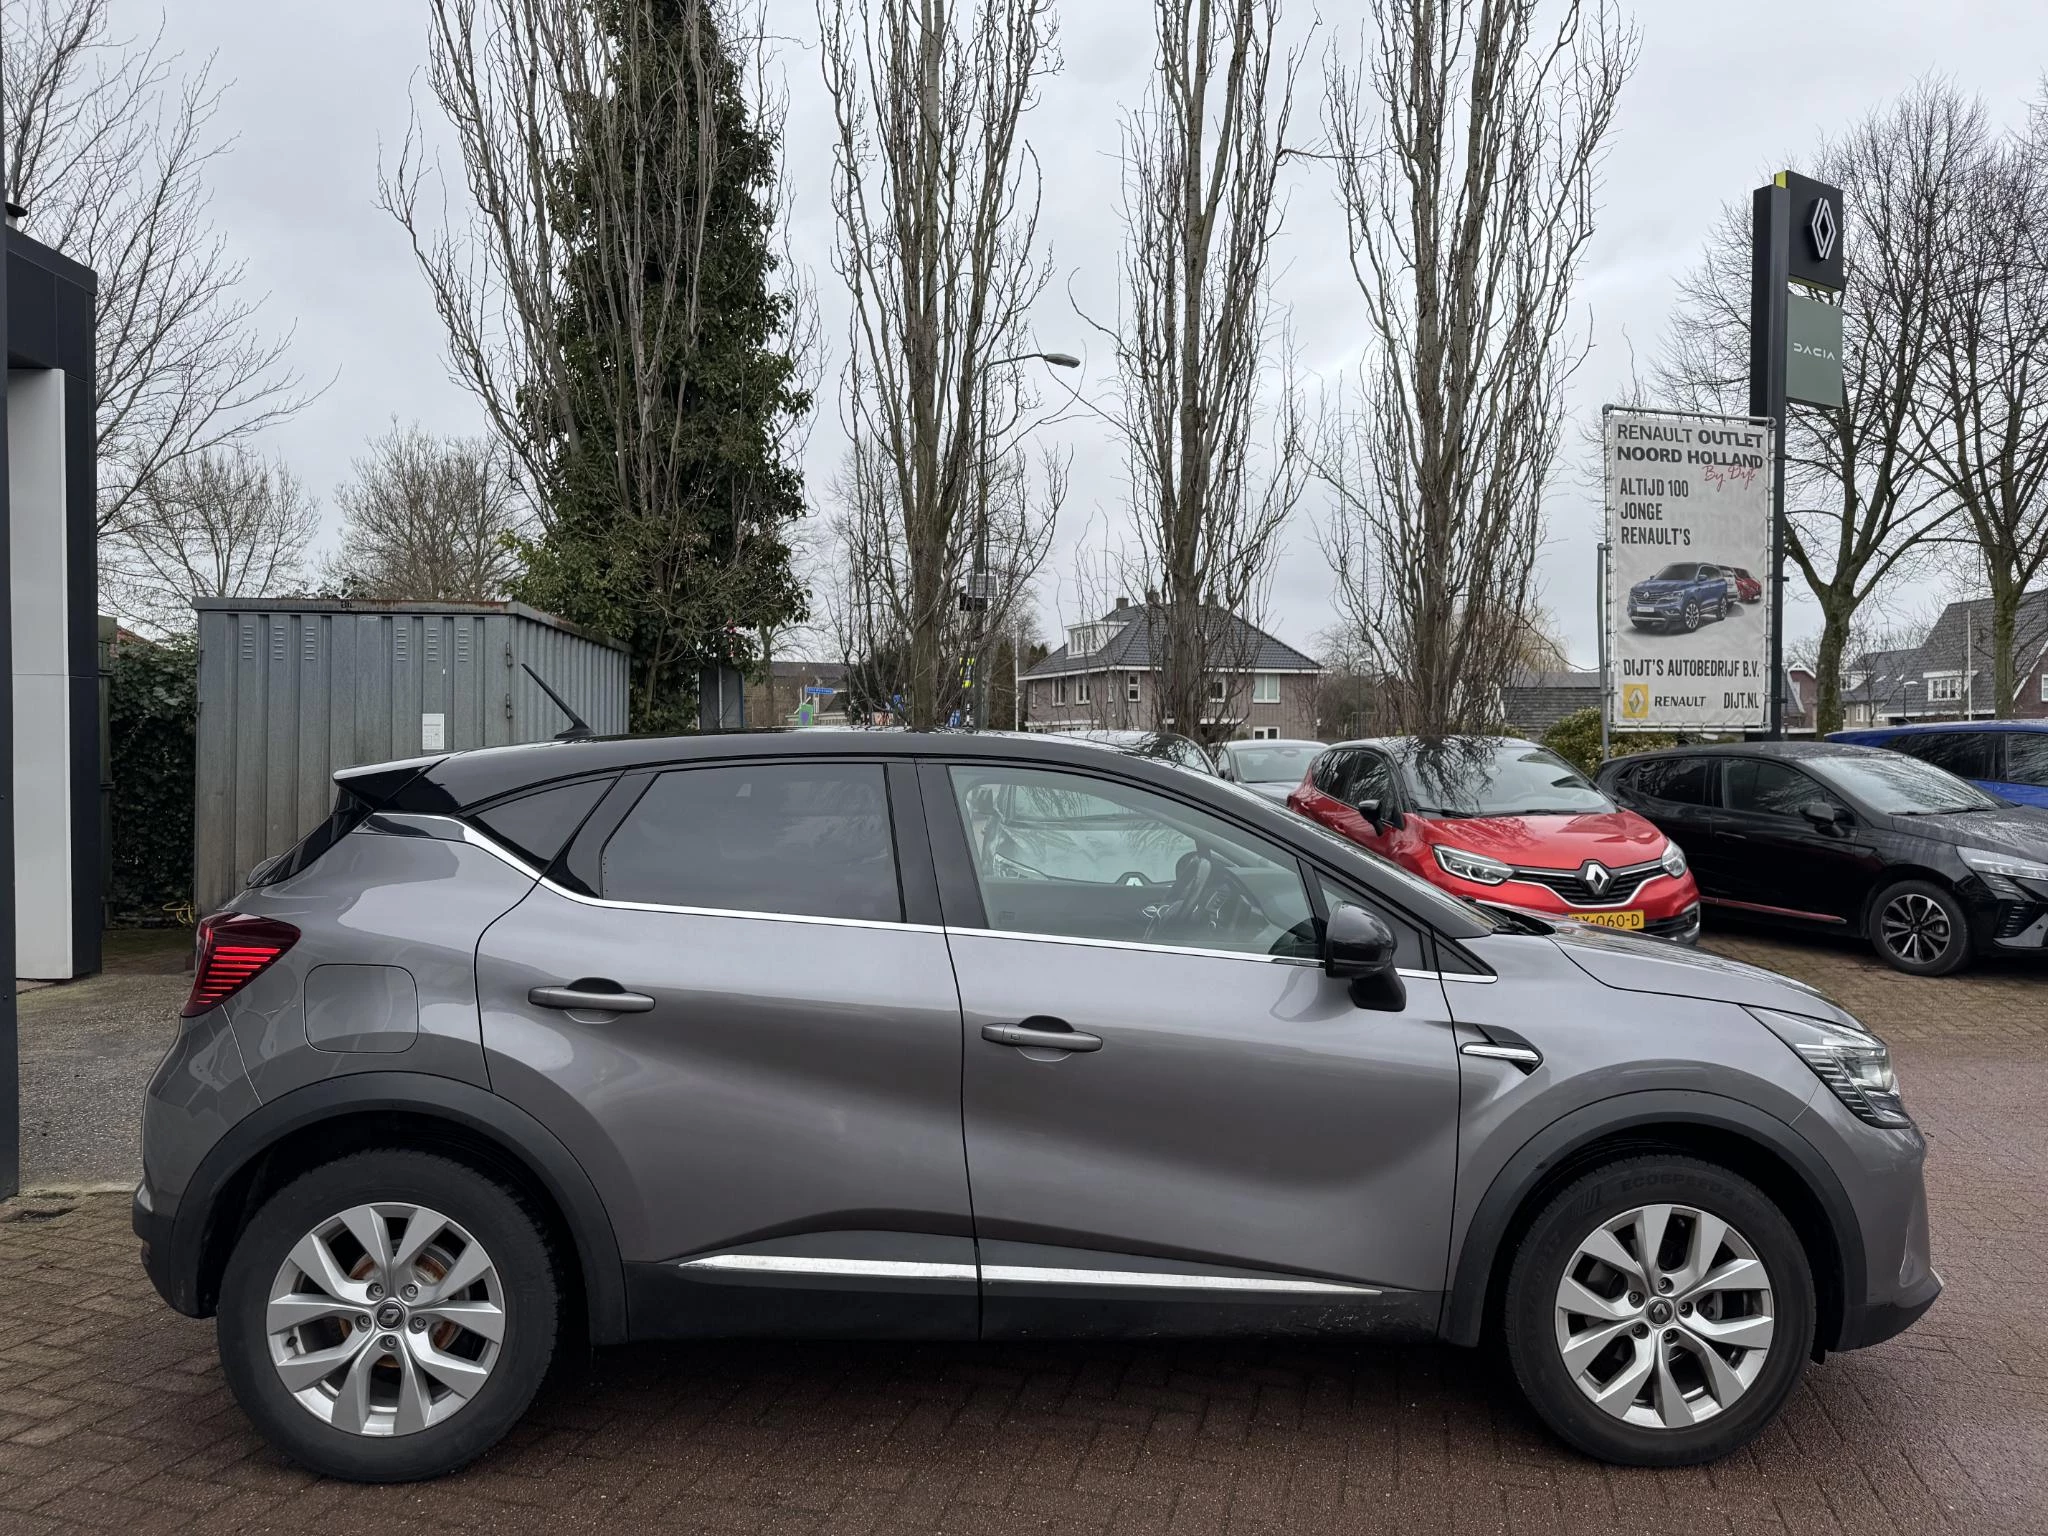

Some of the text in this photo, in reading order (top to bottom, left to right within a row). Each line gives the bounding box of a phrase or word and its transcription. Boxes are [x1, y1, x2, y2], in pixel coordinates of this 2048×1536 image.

[1793, 342, 1836, 361] DACIA
[1617, 424, 1763, 448] RENAULT OUTLET
[1617, 446, 1763, 469] NOORD HOLLAND
[1620, 477, 1689, 498] ALTIJD 100
[1702, 465, 1726, 493] By
[1620, 502, 1663, 520] JONGE
[1621, 526, 1691, 546] RENAULT'S
[1623, 658, 1760, 677] DIJT'S AUTOBEDRIJF B.V.
[1654, 696, 1707, 707] RENAULT
[1723, 692, 1760, 709] DIJT.NL
